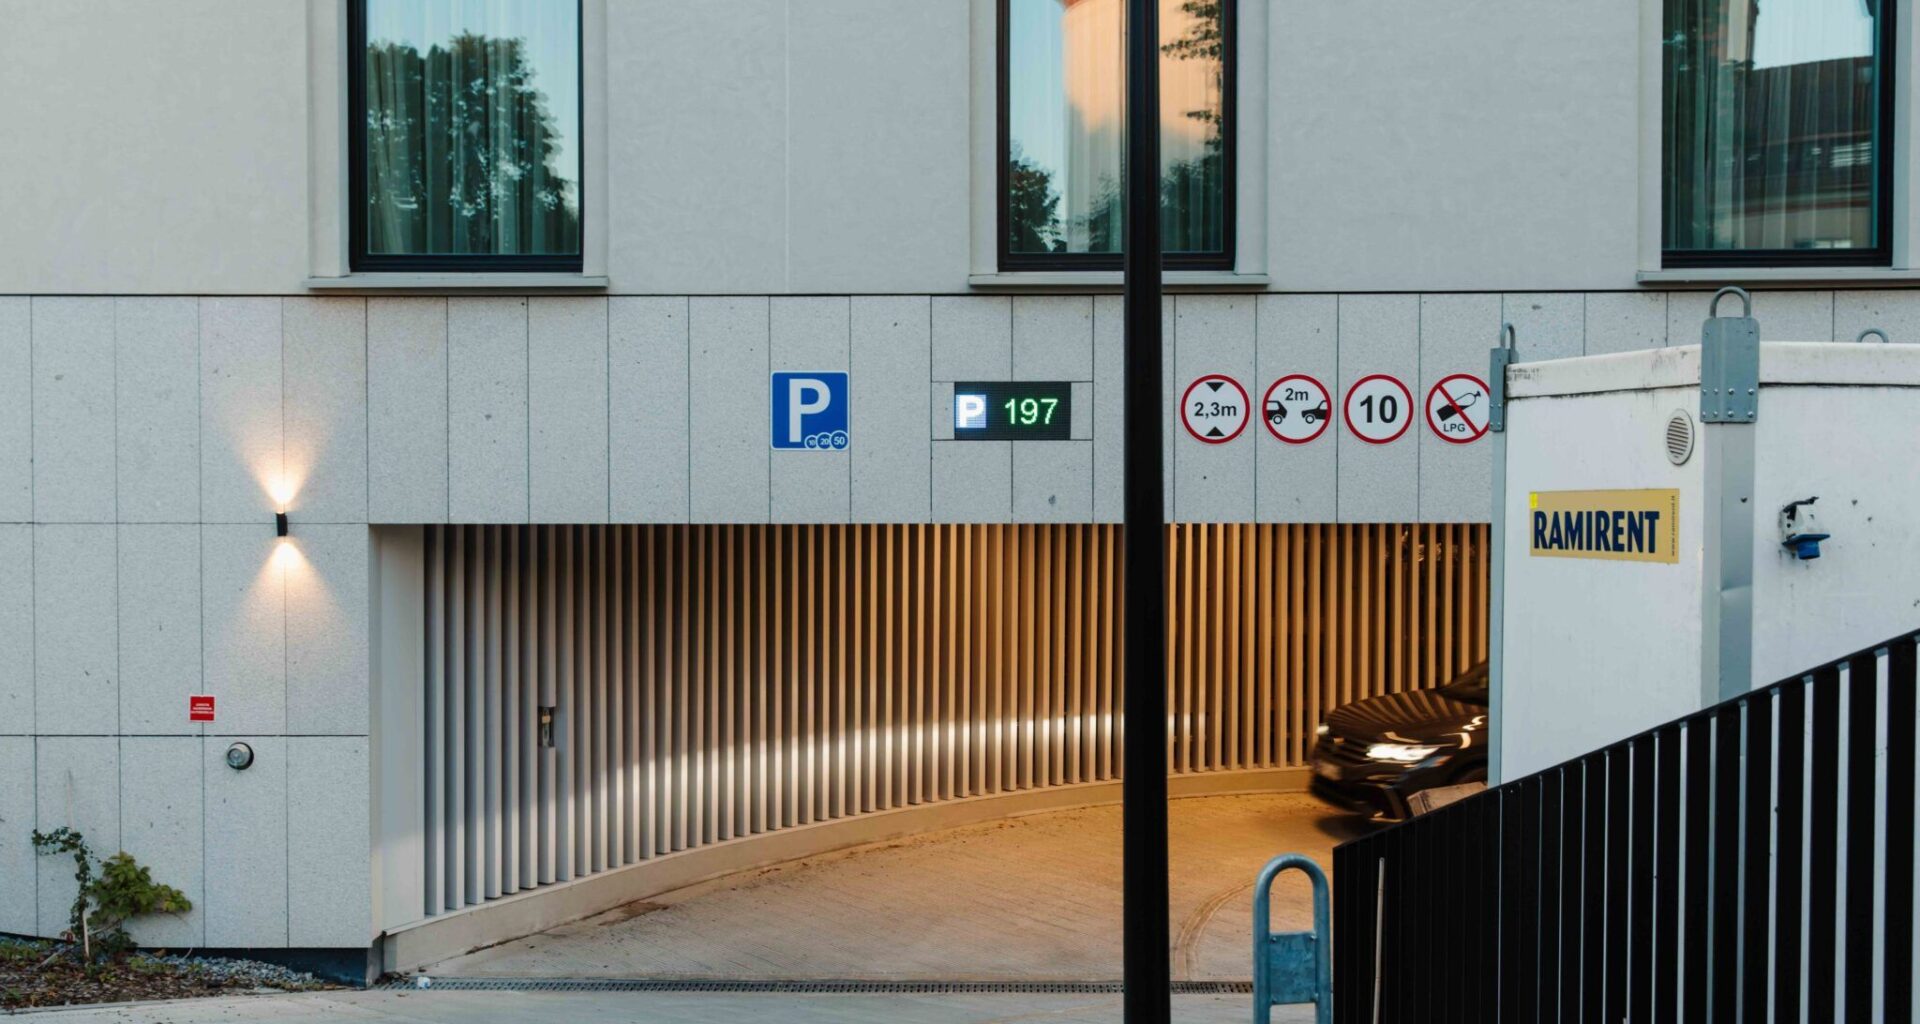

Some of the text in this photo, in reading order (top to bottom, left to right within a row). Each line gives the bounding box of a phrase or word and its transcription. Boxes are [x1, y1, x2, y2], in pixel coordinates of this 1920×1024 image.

[1285, 388, 1309, 401] 2m
[789, 378, 831, 443] P
[959, 396, 1059, 428] P 197
[1194, 402, 1237, 419] 2,3m
[1360, 395, 1398, 423] 10
[1443, 423, 1466, 433] LPG
[833, 436, 846, 446] 50
[1534, 510, 1660, 554] RAMIRENT
